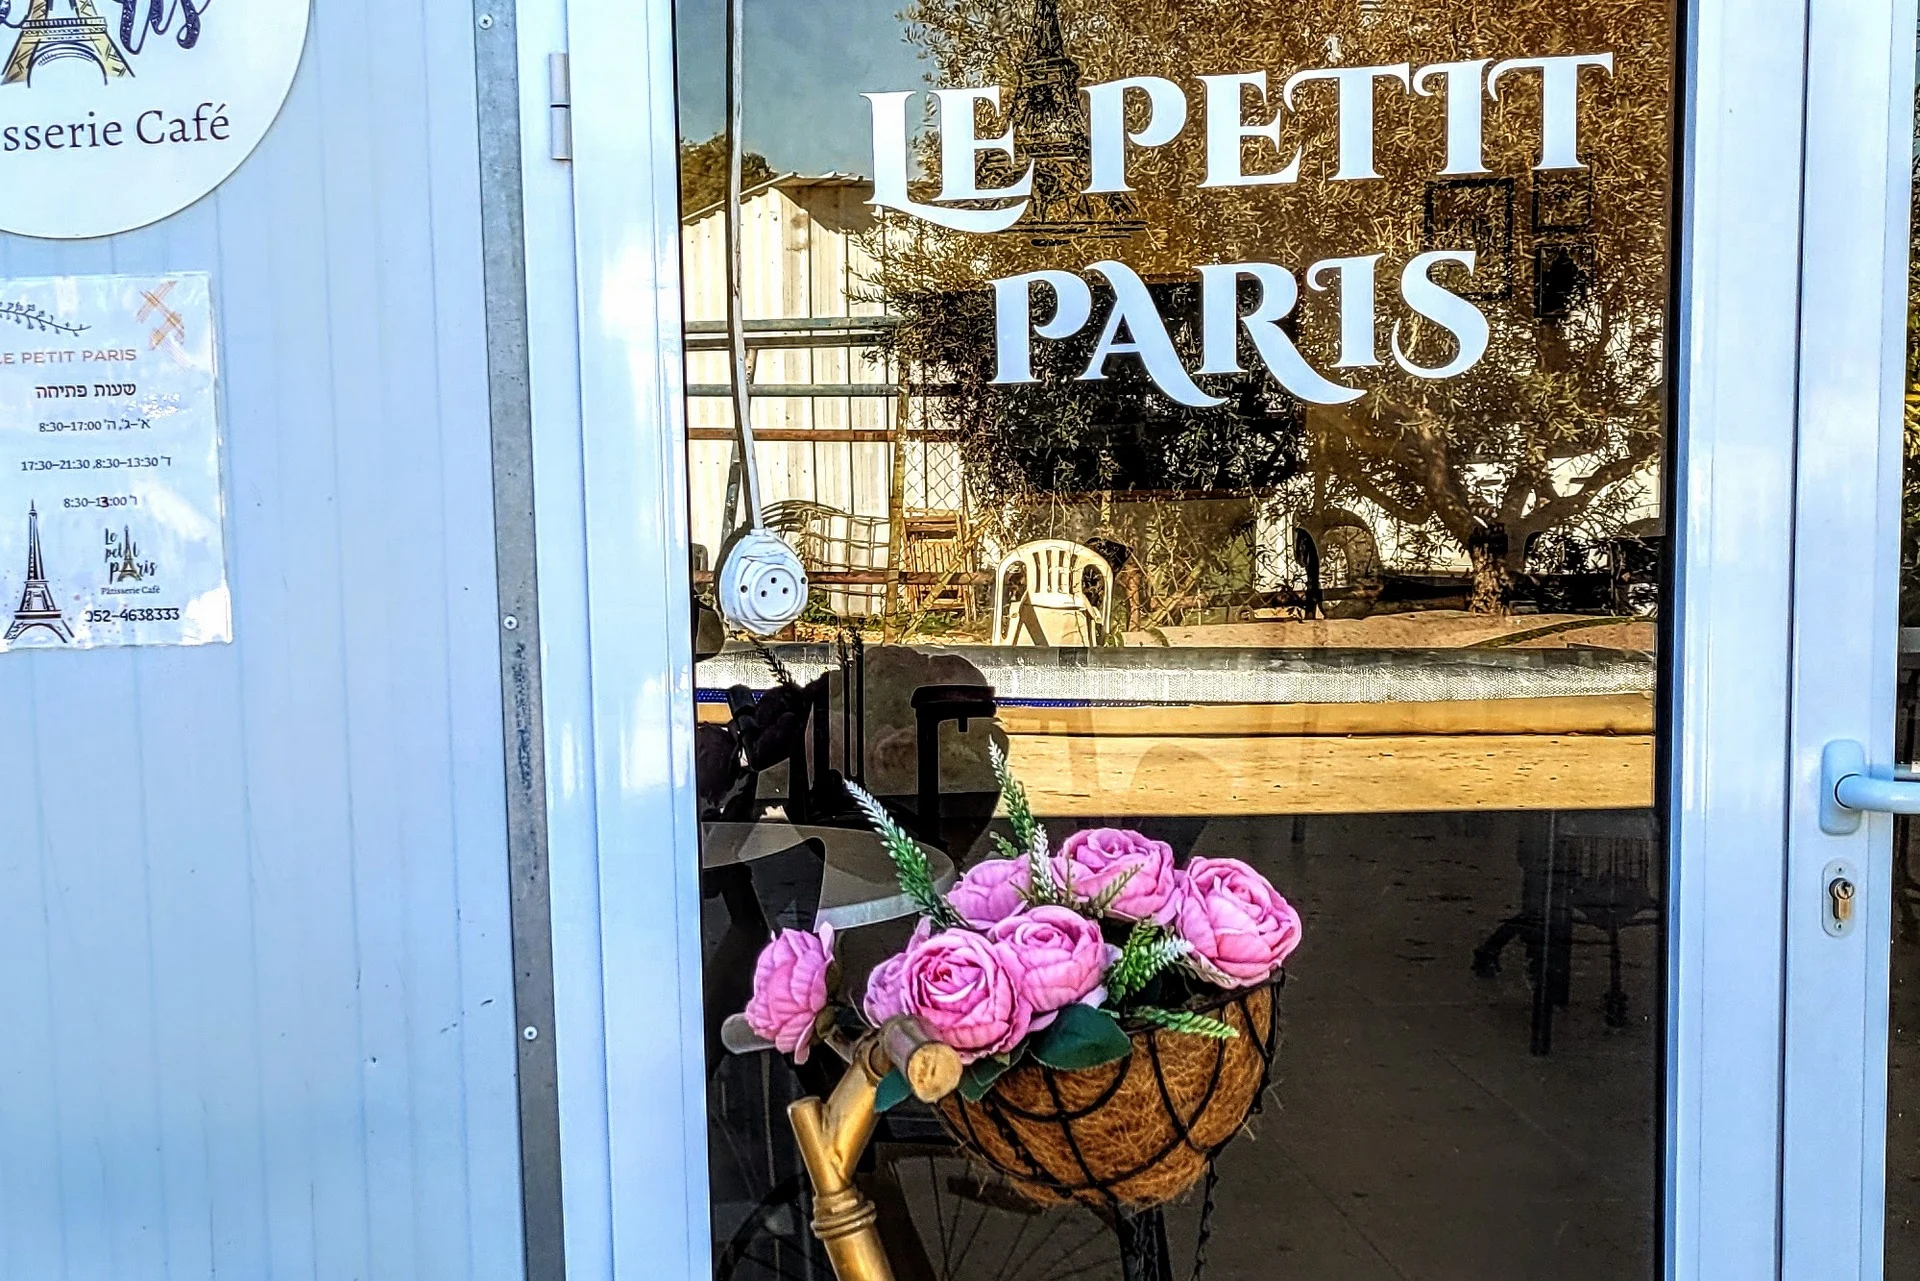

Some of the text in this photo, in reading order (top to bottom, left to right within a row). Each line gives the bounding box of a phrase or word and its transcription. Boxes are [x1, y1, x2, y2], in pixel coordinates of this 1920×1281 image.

[135, 102, 231, 145] Café
[860, 52, 1614, 234] LE PETIT
[987, 248, 1493, 408] PARIS
[0, 349, 137, 365] E PETIT PARIS
[35, 383, 137, 399] שעות פתיחה
[84, 606, 180, 623] 052-4638333
